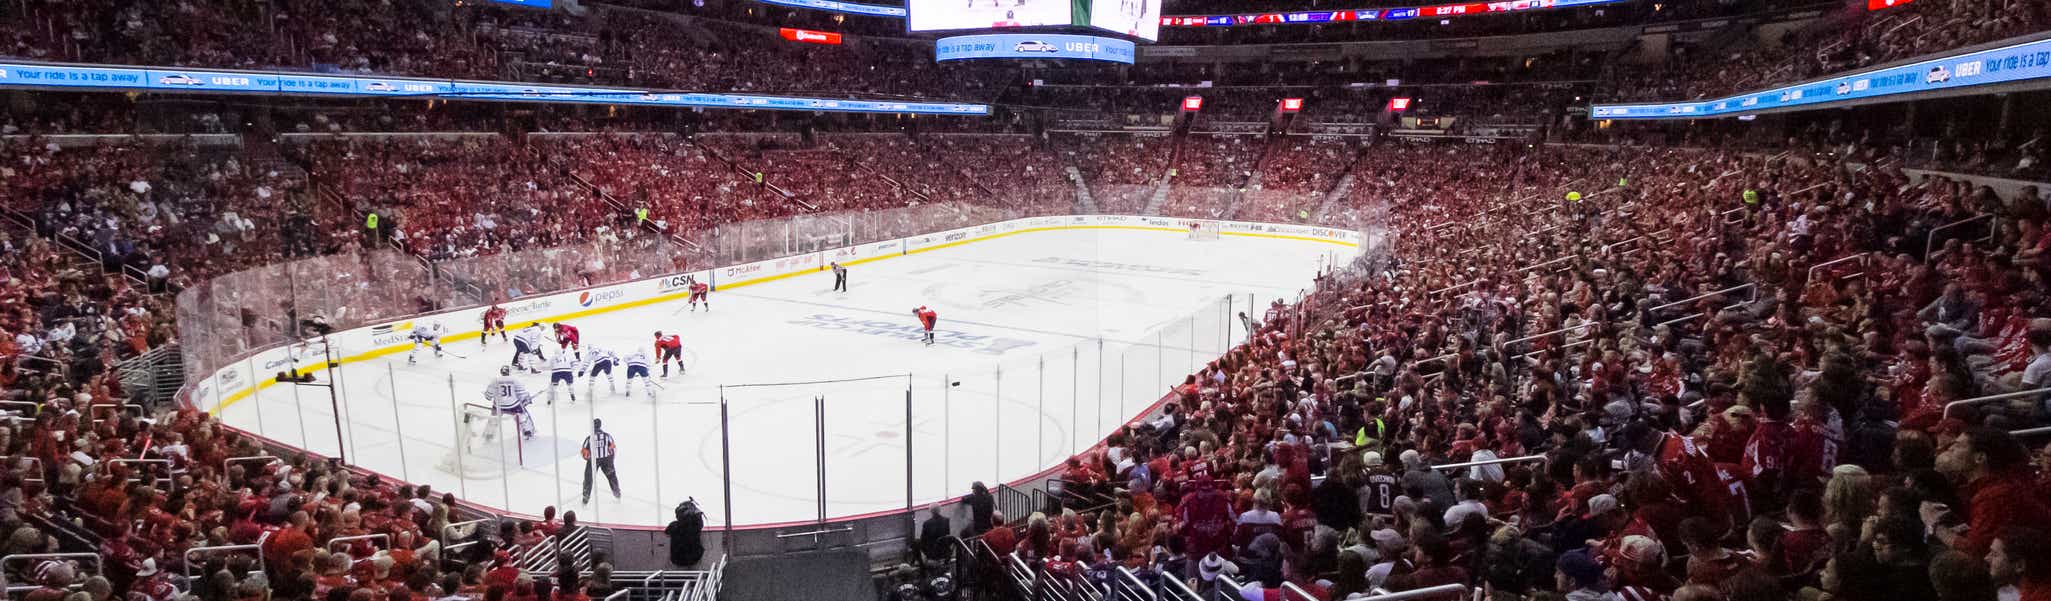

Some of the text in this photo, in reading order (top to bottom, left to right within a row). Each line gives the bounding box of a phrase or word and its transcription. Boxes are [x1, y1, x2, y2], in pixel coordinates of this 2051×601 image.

[974, 43, 995, 52] away
[1065, 41, 1099, 53] UBER
[1955, 51, 2050, 78] UBER Your ride is a tap
[16, 69, 41, 79] Your
[45, 70, 65, 80] ride
[69, 72, 79, 80] is
[91, 71, 108, 82] tap
[111, 73, 138, 83] away
[211, 76, 249, 86] UBER
[257, 78, 276, 87] Your
[316, 80, 329, 88] tap
[330, 81, 351, 90] away
[672, 274, 695, 287] CSN
[595, 288, 625, 304] pepsi
[500, 385, 512, 397] 31
[1380, 484, 1390, 509] 8
